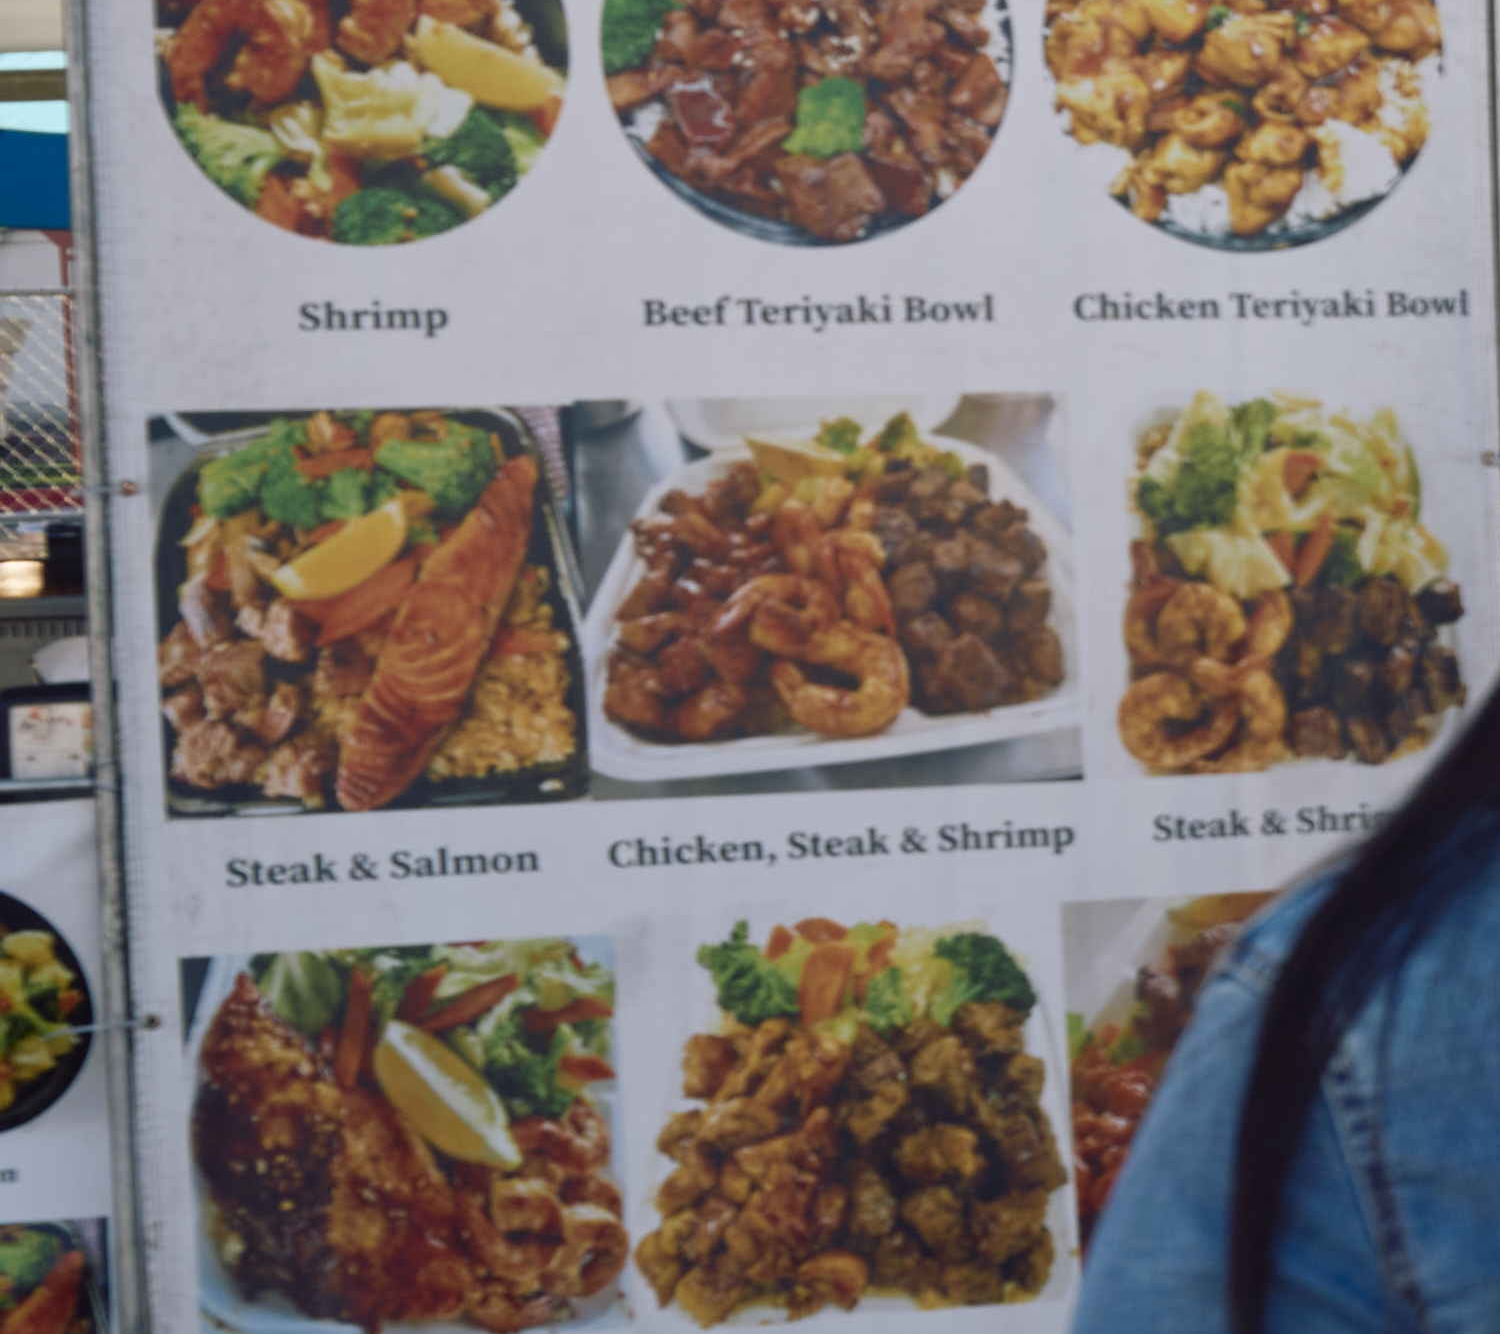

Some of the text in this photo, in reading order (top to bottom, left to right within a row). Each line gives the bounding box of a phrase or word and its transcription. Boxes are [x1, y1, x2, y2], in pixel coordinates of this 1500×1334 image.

[298, 299, 450, 339] Shrimp
[642, 293, 995, 334] Beef Teriyaki Bowl
[1072, 288, 1471, 327] Chicken Teriyaki Bowl
[607, 820, 1077, 869] Chicken, Steak & Shrimp
[1150, 809, 1250, 845] Steak
[1260, 808, 1286, 835] &
[225, 846, 540, 889] Steak & Salmon
